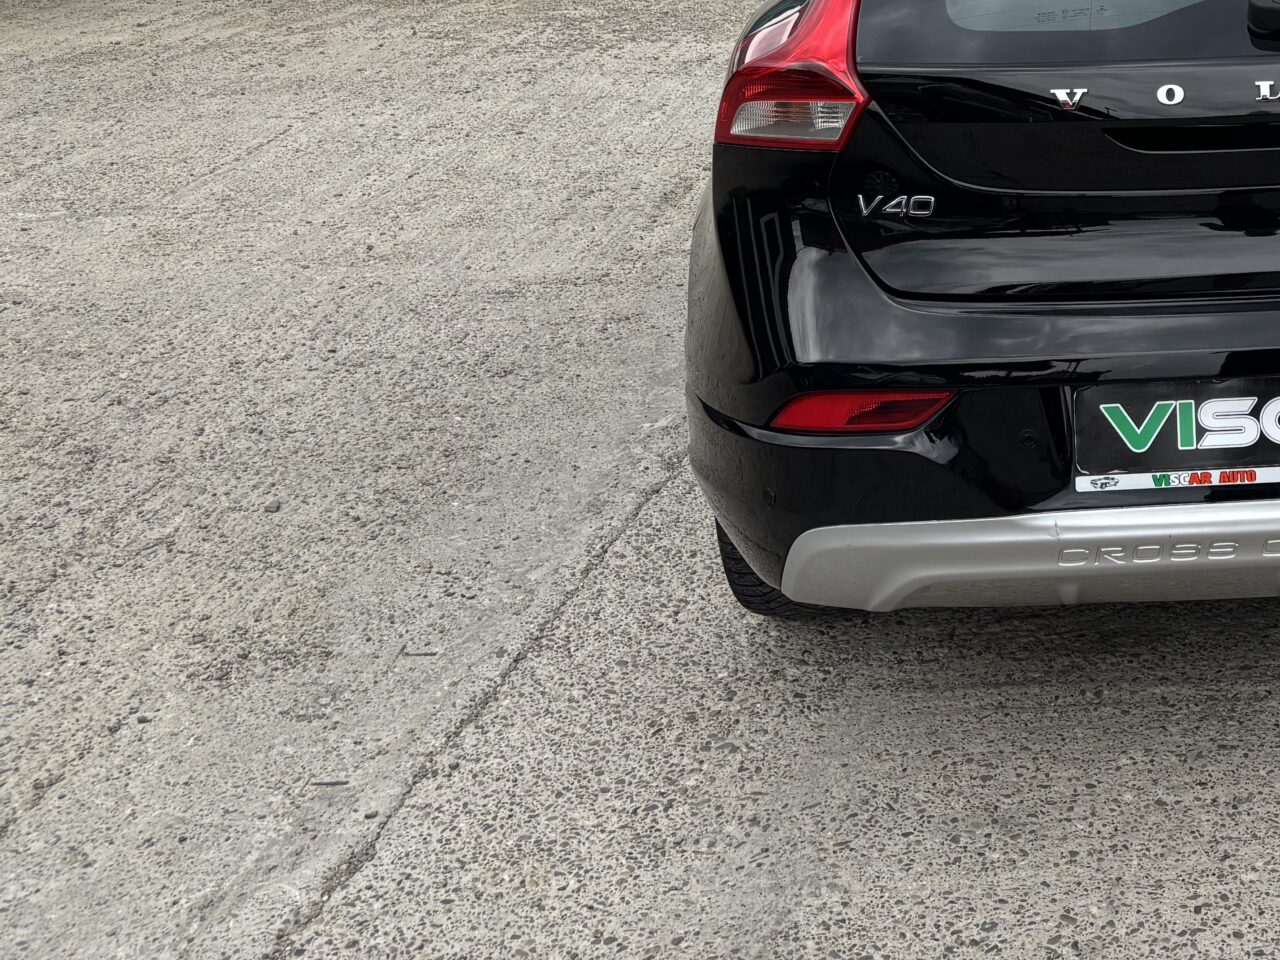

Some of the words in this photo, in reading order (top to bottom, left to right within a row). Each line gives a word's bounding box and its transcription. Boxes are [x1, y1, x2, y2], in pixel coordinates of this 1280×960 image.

[857, 194, 935, 217] V40
[1151, 471, 1213, 488] VISCAR
[1218, 469, 1257, 484] AUTO
[1057, 542, 1240, 567] CROSS
